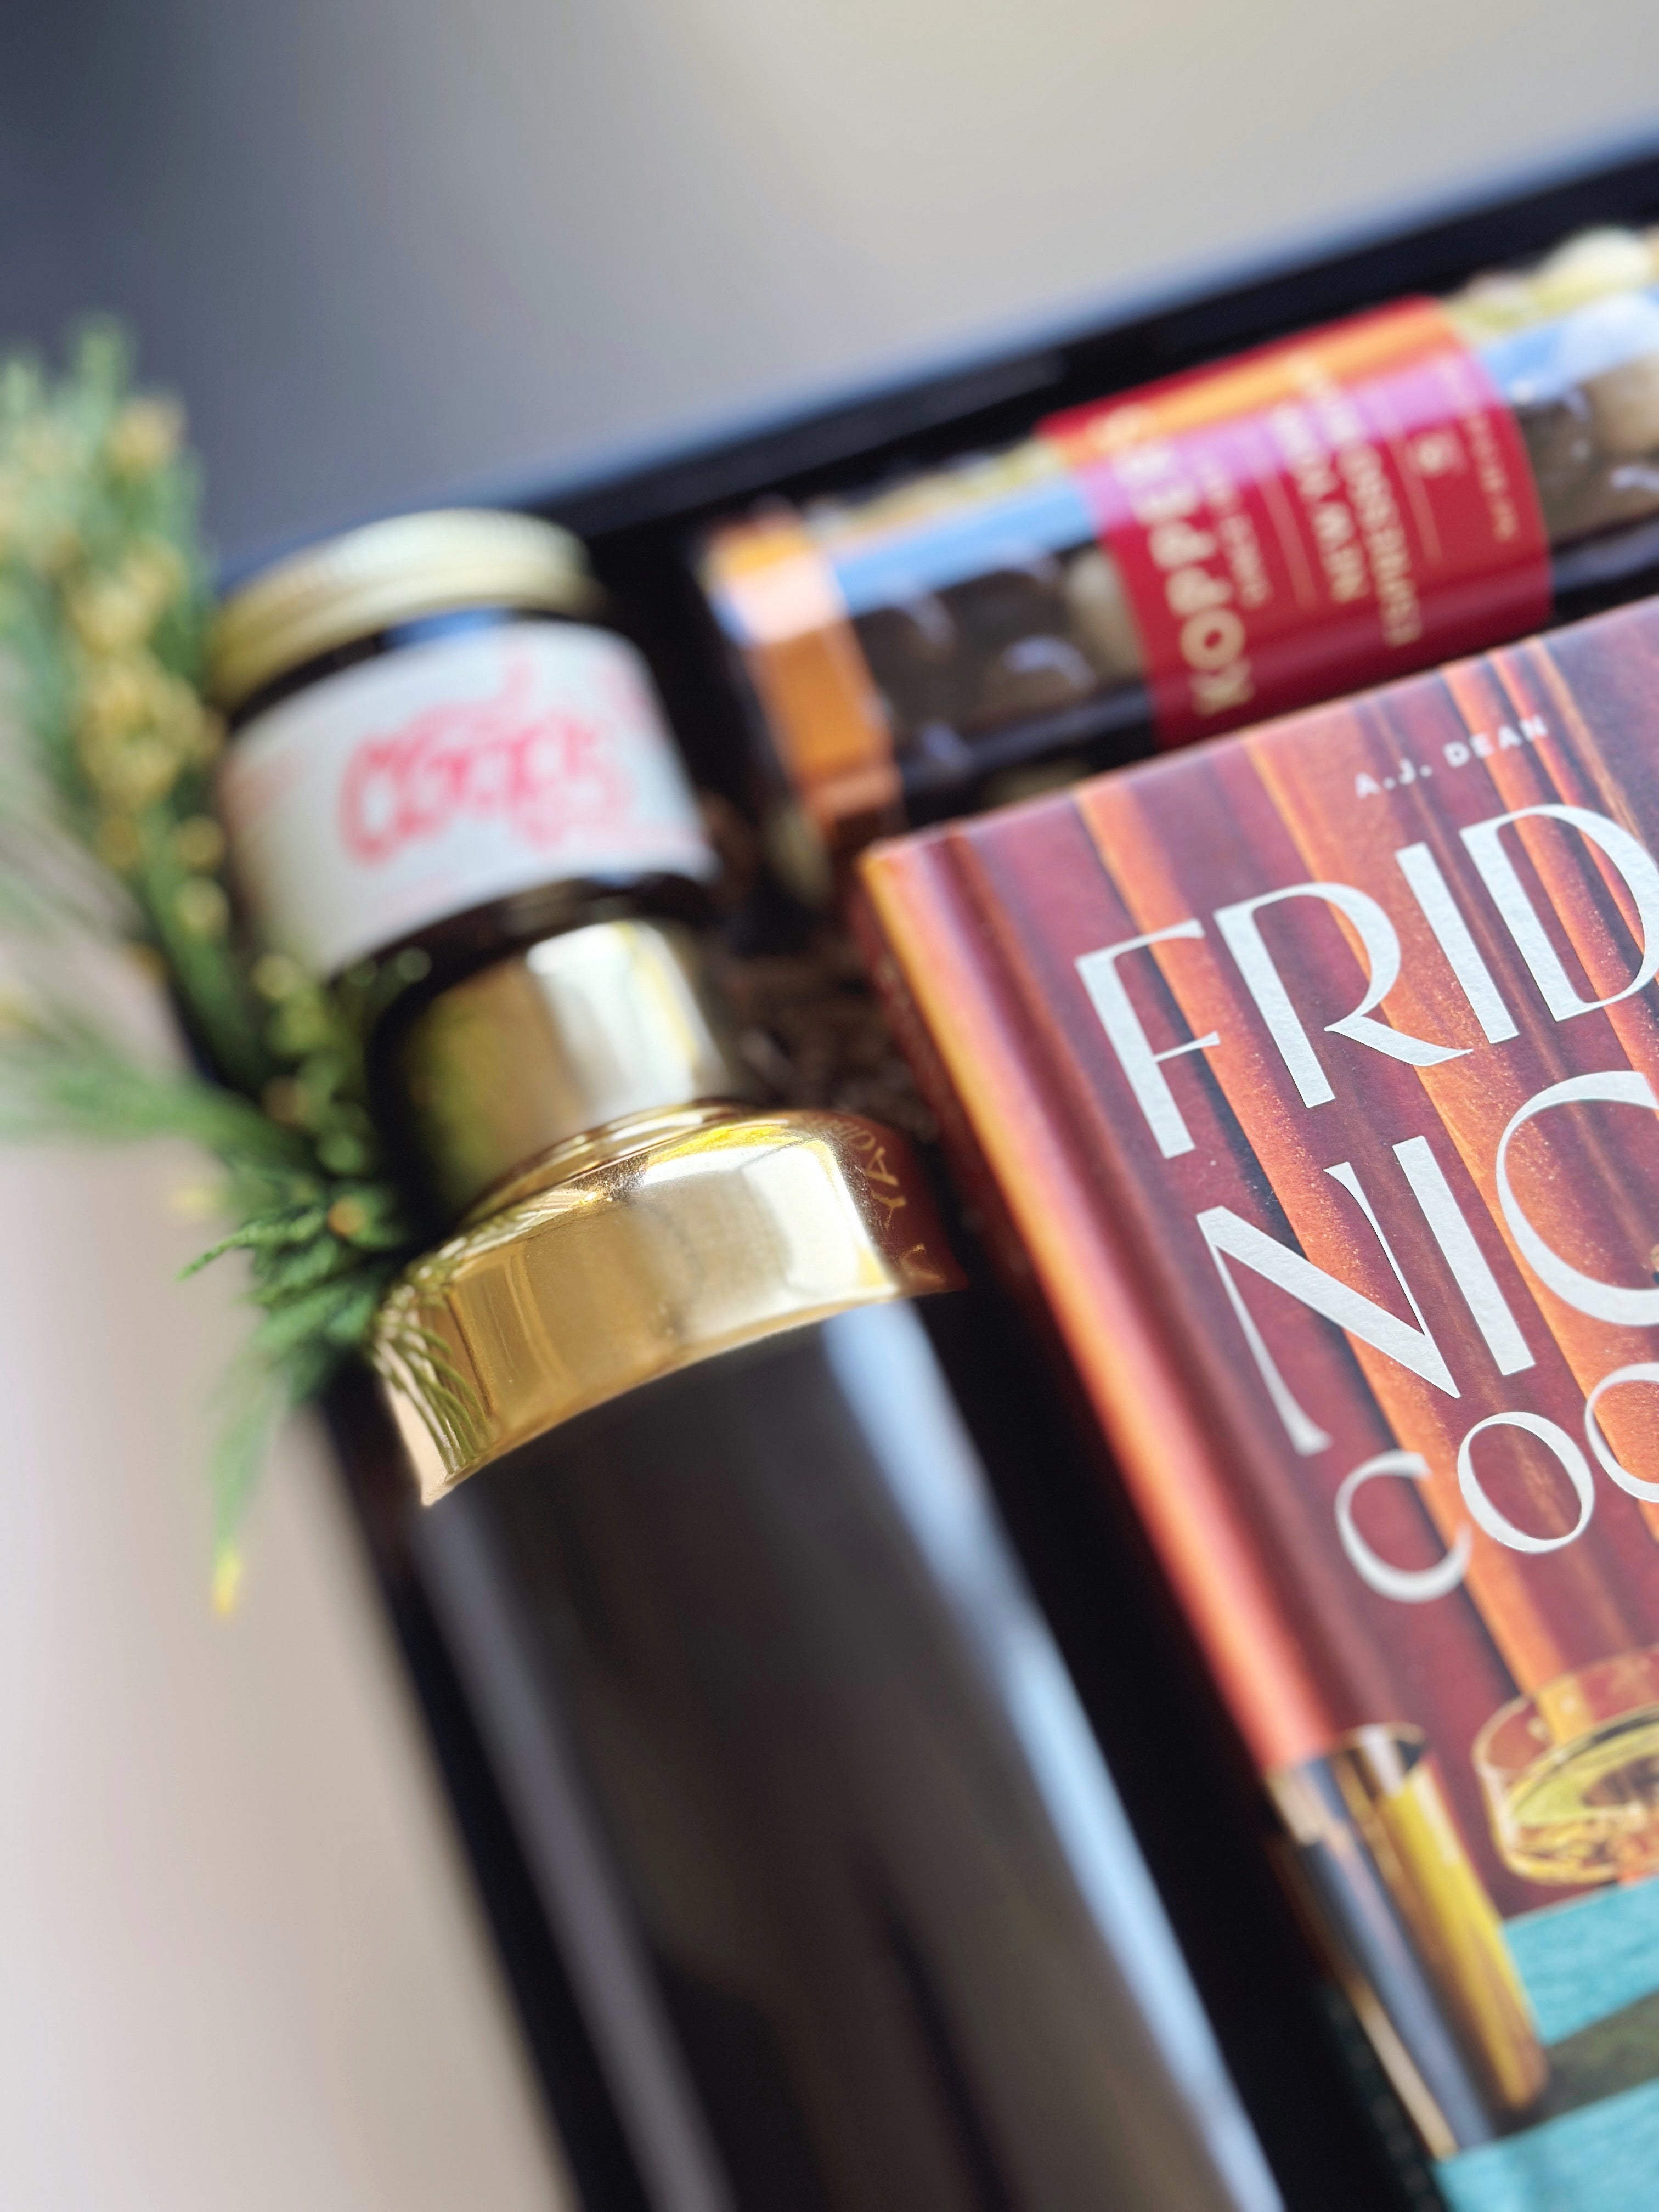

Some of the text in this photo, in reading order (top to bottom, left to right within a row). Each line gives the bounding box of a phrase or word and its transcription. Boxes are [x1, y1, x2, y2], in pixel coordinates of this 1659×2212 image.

[1355, 715, 1548, 799] A.J. DEAN
[1074, 803, 1659, 1159] FRID
